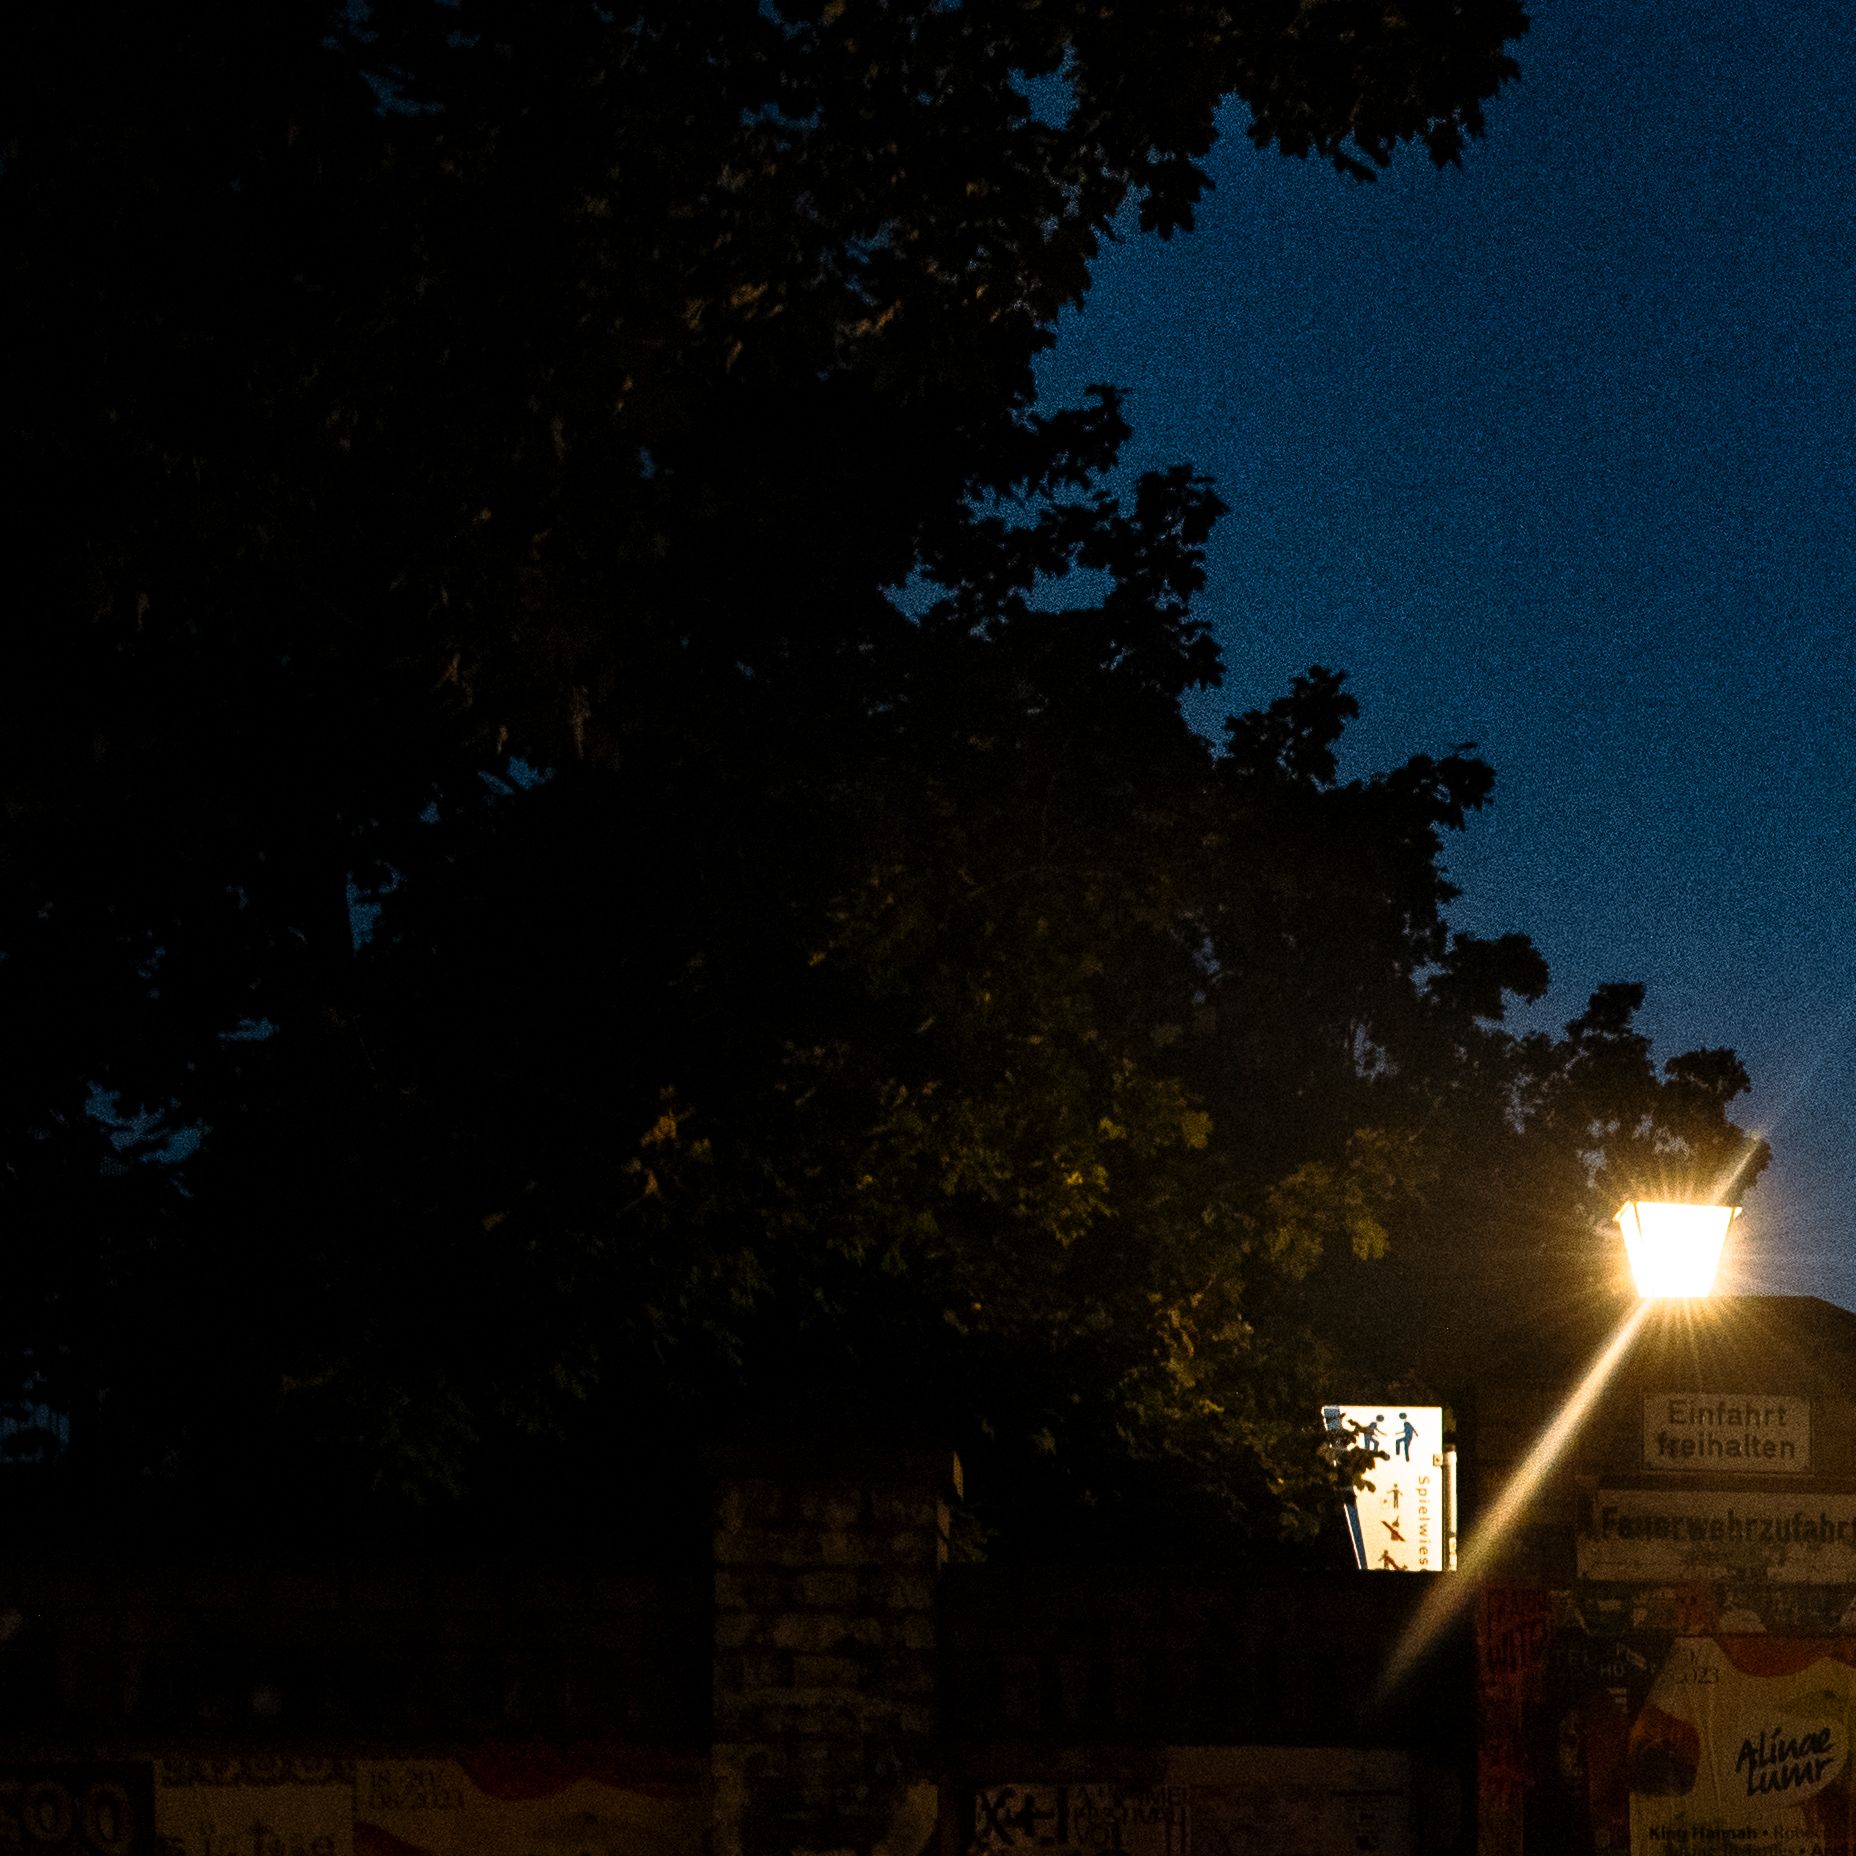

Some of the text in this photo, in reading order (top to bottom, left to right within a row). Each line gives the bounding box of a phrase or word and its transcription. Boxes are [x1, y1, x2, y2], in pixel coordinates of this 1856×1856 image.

[1668, 1398, 1788, 1429] Einfahrt
[1657, 1431, 1796, 1460] freihalten
[1416, 1474, 1430, 1570] Spielwies
